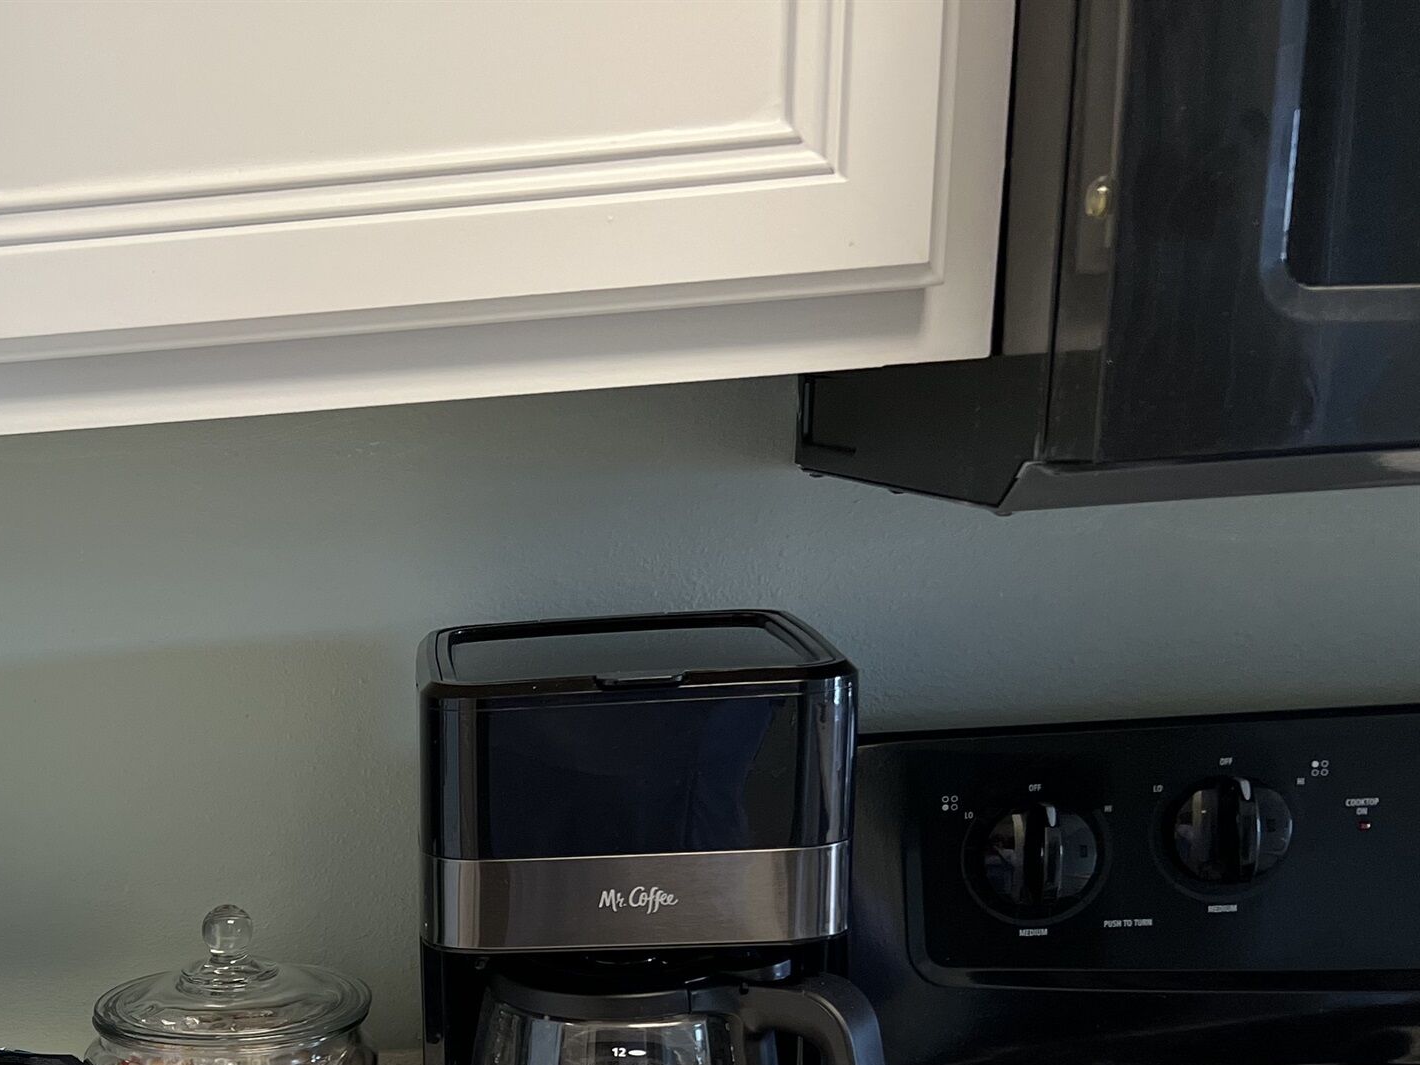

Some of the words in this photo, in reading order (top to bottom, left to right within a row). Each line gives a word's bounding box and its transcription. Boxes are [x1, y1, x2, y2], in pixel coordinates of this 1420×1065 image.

[1219, 758, 1233, 766] OFF
[1029, 784, 1042, 792] OFF
[1153, 785, 1163, 793] LO
[1345, 797, 1380, 807] COOKTOP
[964, 811, 974, 820] LO
[1355, 807, 1368, 816] ON
[598, 888, 627, 912] Mr.
[628, 886, 679, 914] Coffee
[1103, 919, 1122, 928] PUSH
[1123, 919, 1132, 927] TO
[1133, 918, 1153, 927] TURN
[1019, 928, 1048, 937] MEDIUM
[611, 1047, 627, 1058] 12
